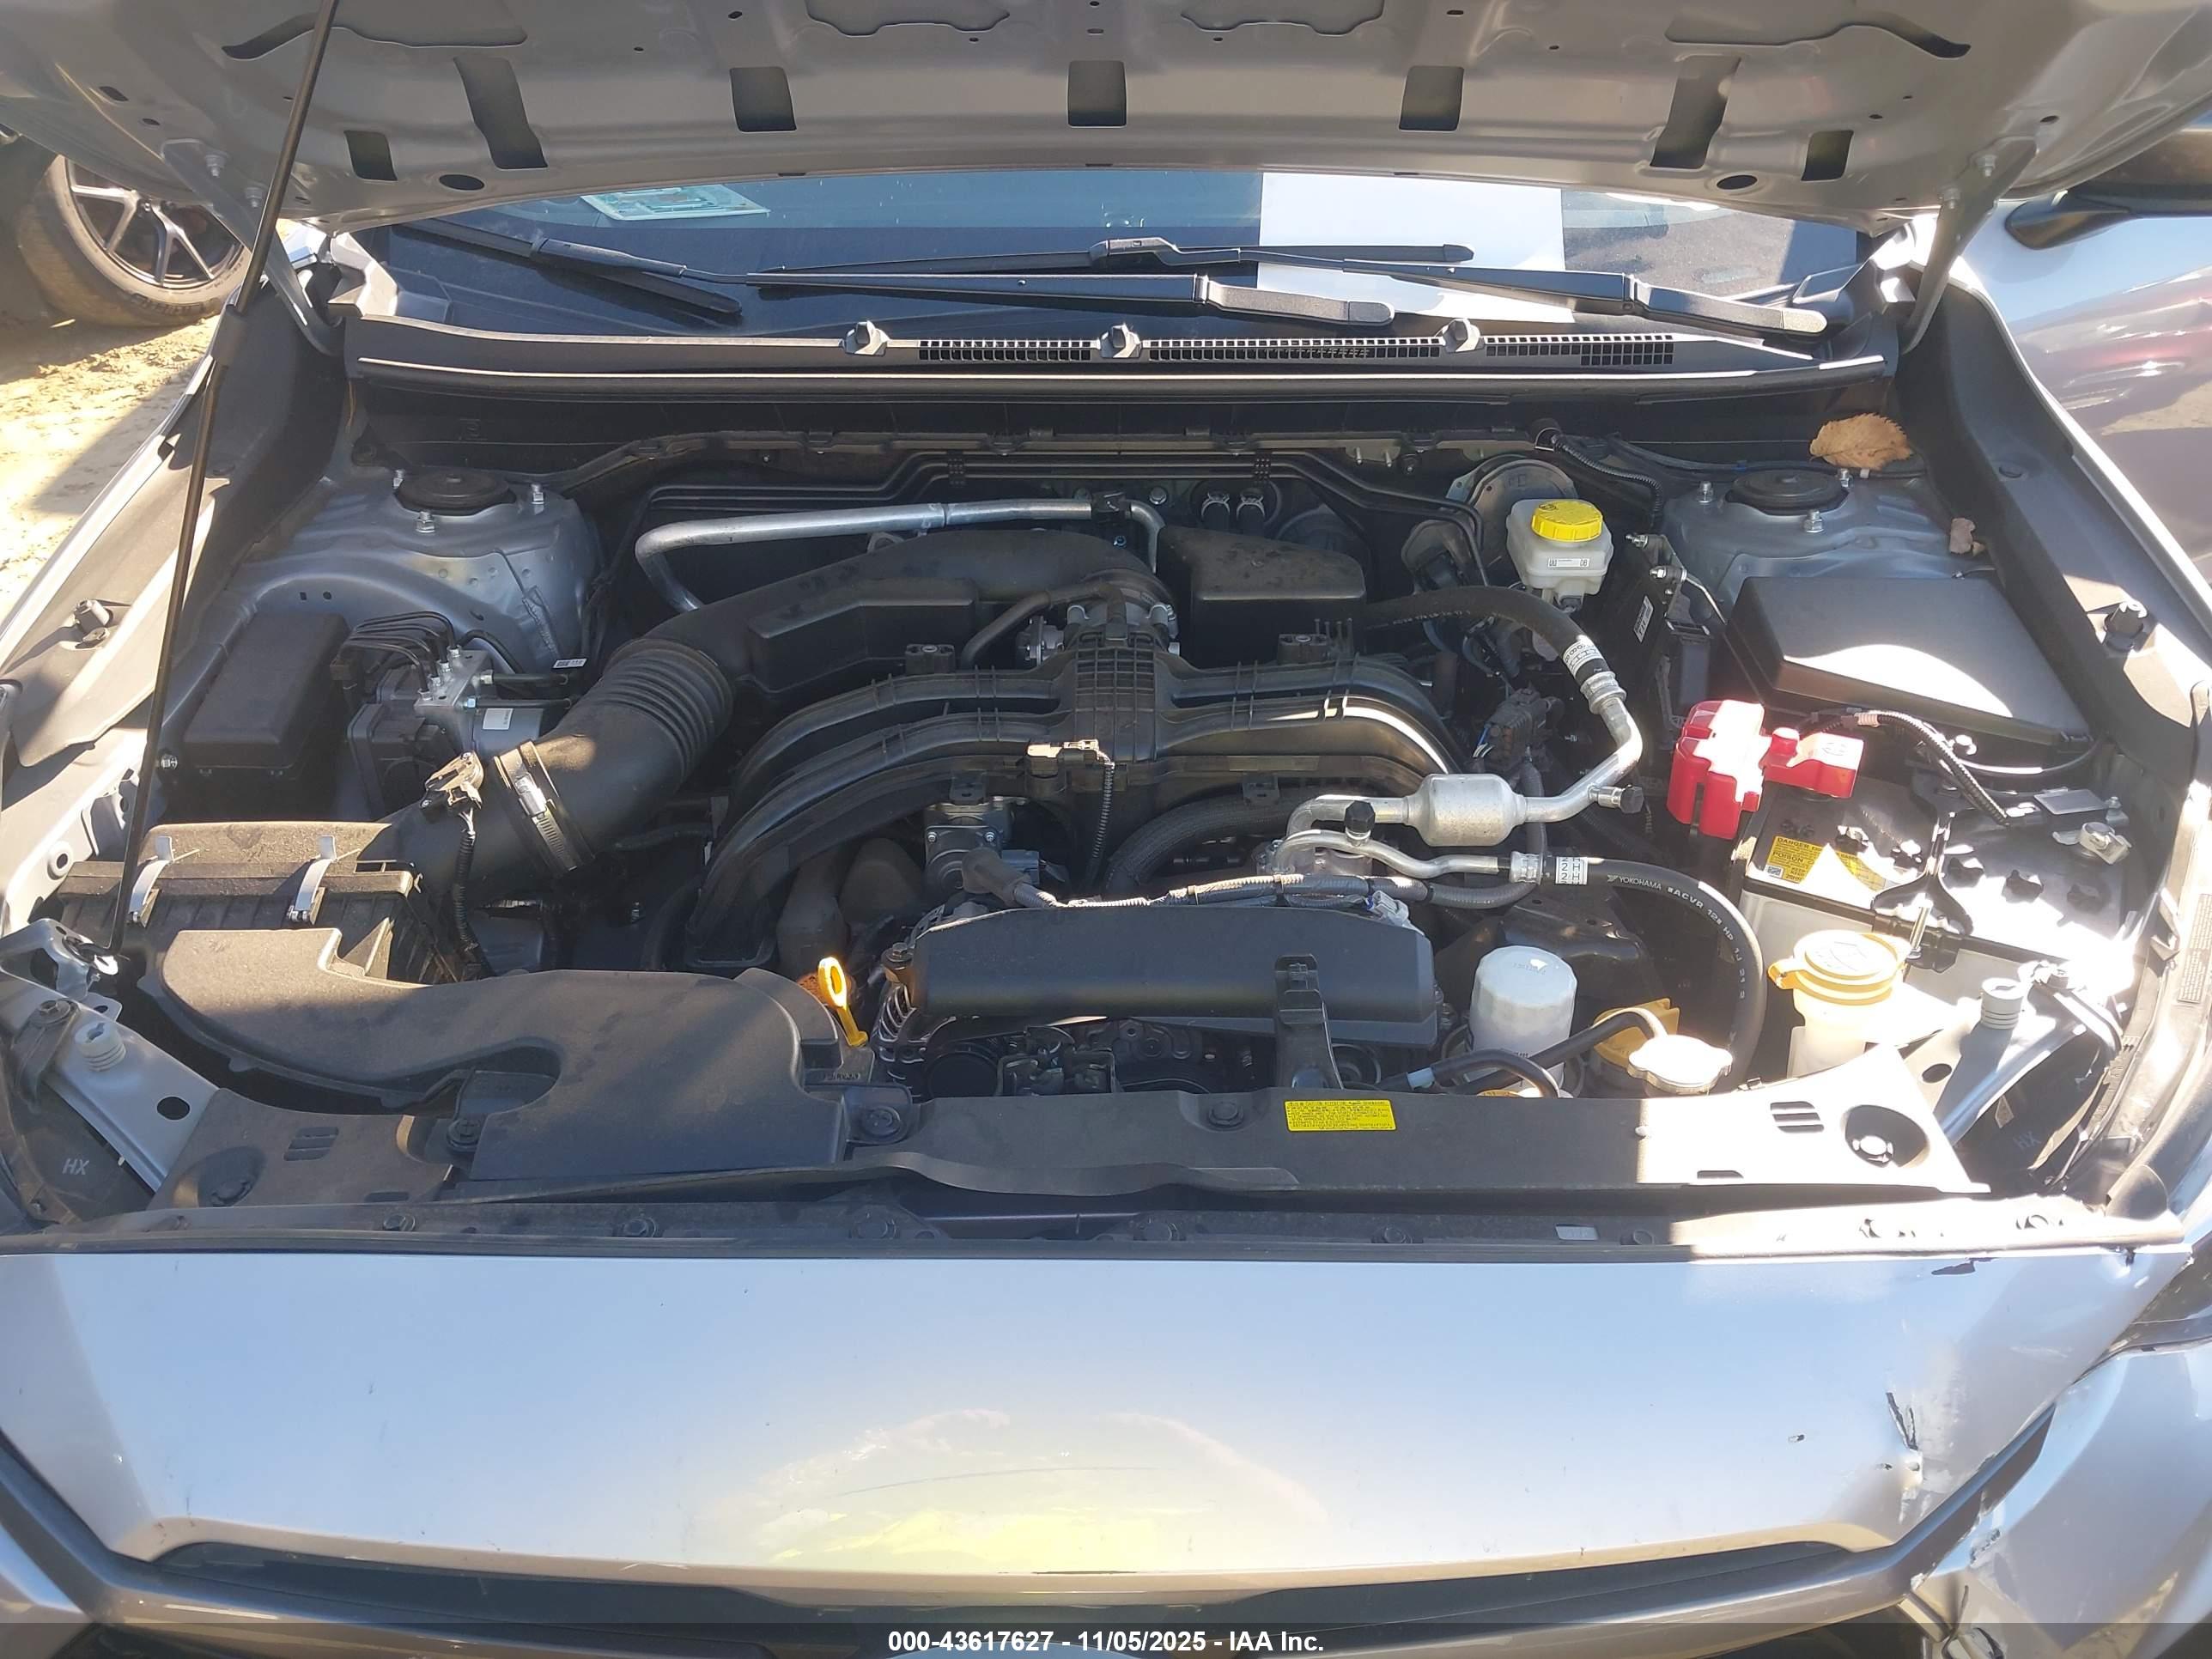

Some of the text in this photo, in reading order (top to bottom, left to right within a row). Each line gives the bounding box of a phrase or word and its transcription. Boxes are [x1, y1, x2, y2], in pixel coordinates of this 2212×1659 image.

[1778, 837, 1810, 850] DANGER
[1772, 851, 1804, 863] POISON
[1619, 876, 1662, 891] YOKOHAMA
[62, 1158, 90, 1176] HX
